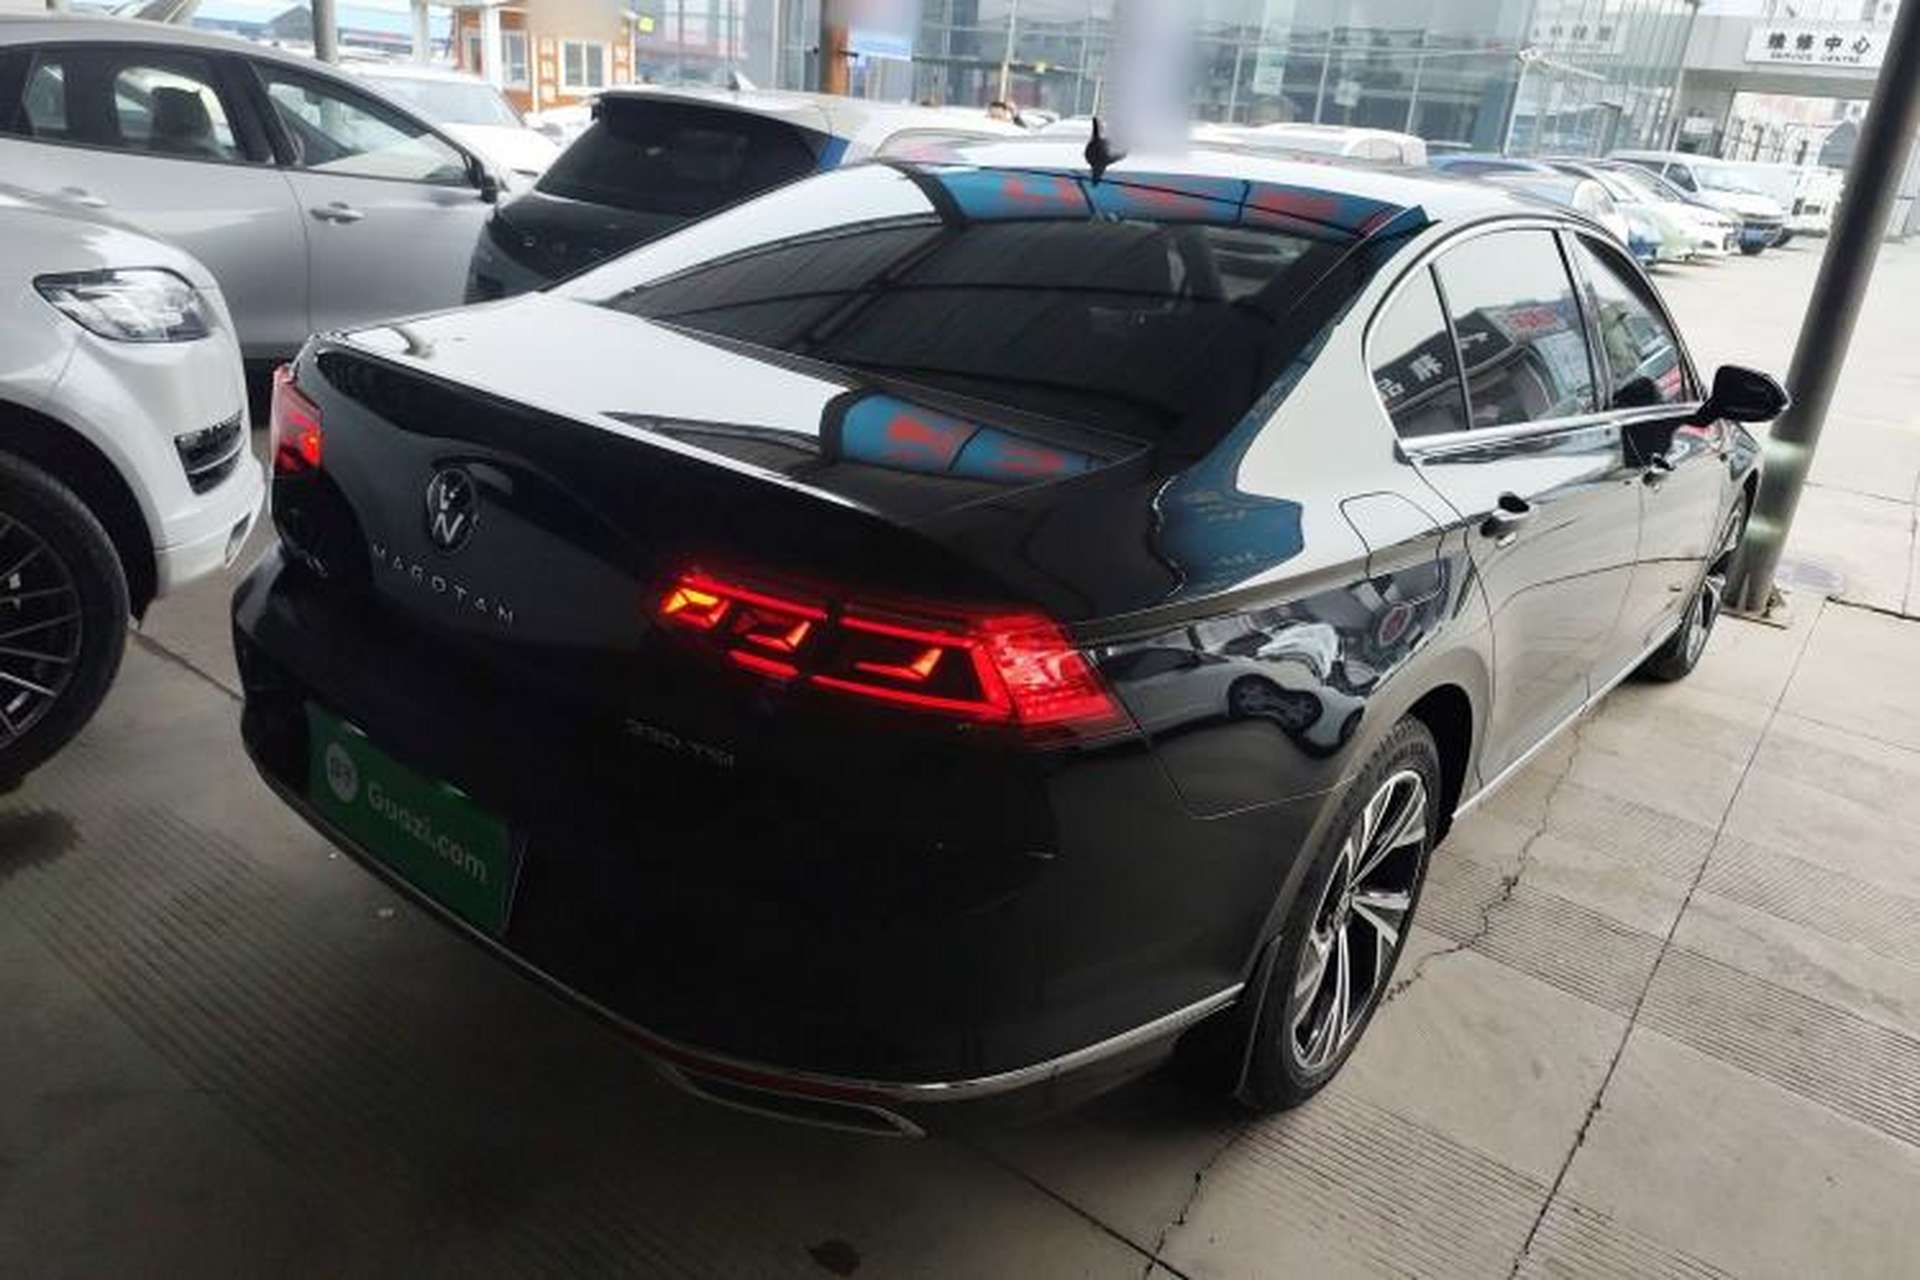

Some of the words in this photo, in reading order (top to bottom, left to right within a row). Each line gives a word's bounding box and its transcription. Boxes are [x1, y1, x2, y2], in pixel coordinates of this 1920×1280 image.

[1767, 31, 1871, 54] 维修中心
[367, 781, 488, 882] Guazi.com
